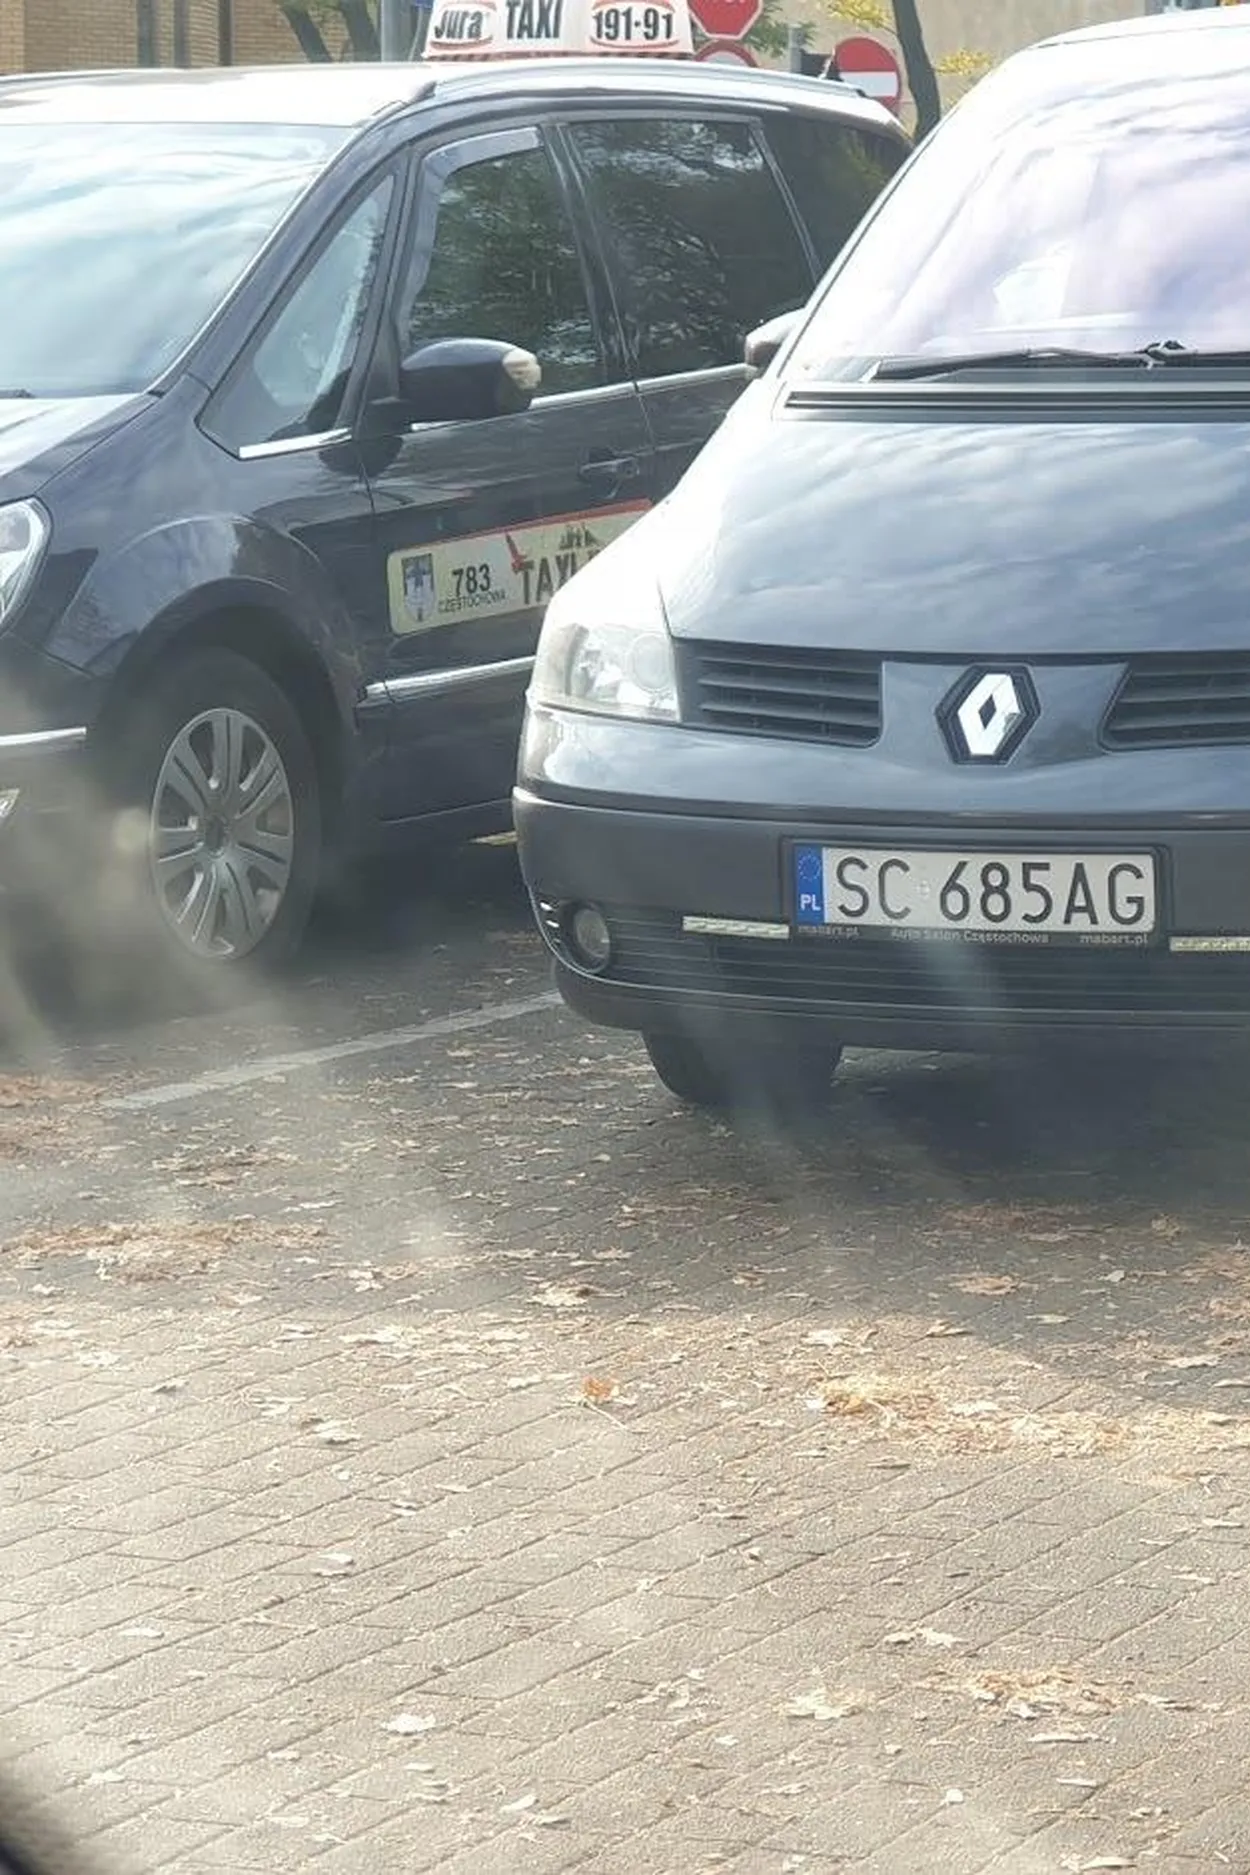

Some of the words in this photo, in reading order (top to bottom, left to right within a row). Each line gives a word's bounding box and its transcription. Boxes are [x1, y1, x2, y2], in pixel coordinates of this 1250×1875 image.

[434, 8, 485, 40] Jura
[506, 0, 564, 39] TAXI
[452, 563, 491, 598] 783
[800, 894, 822, 911] PL
[836, 856, 912, 920] SC
[939, 860, 1146, 925] 685AG
